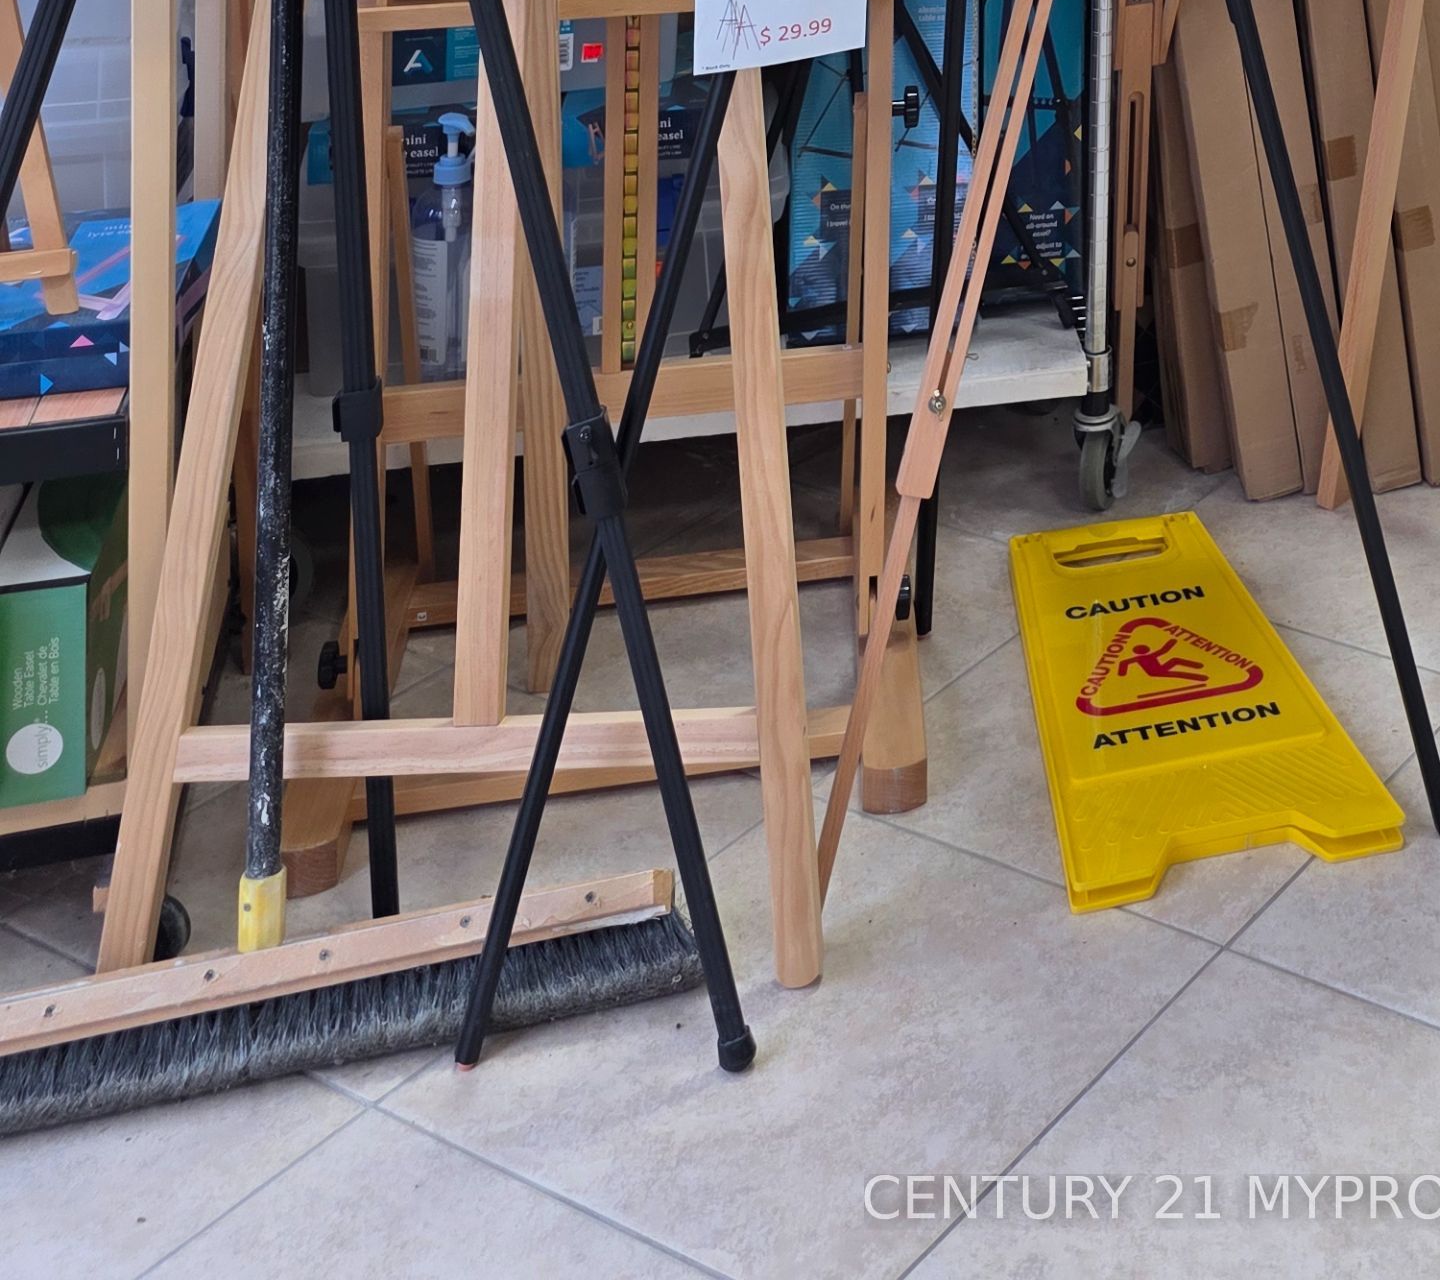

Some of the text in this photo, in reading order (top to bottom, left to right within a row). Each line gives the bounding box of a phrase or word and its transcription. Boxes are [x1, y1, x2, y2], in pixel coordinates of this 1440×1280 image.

[760, 18, 832, 46] $ 29.99
[410, 147, 439, 157] easel
[1066, 586, 1204, 620] CAUTION
[1081, 634, 1131, 697] CAUTION
[1167, 625, 1252, 669] ATTENTION
[13, 667, 23, 710] Wooden
[24, 650, 34, 708] Table Easel
[37, 645, 48, 706] Chevalet de
[49, 637, 59, 704] Table en Bois
[35, 726, 52, 768] simply
[1094, 702, 1281, 749] ATTENTION
